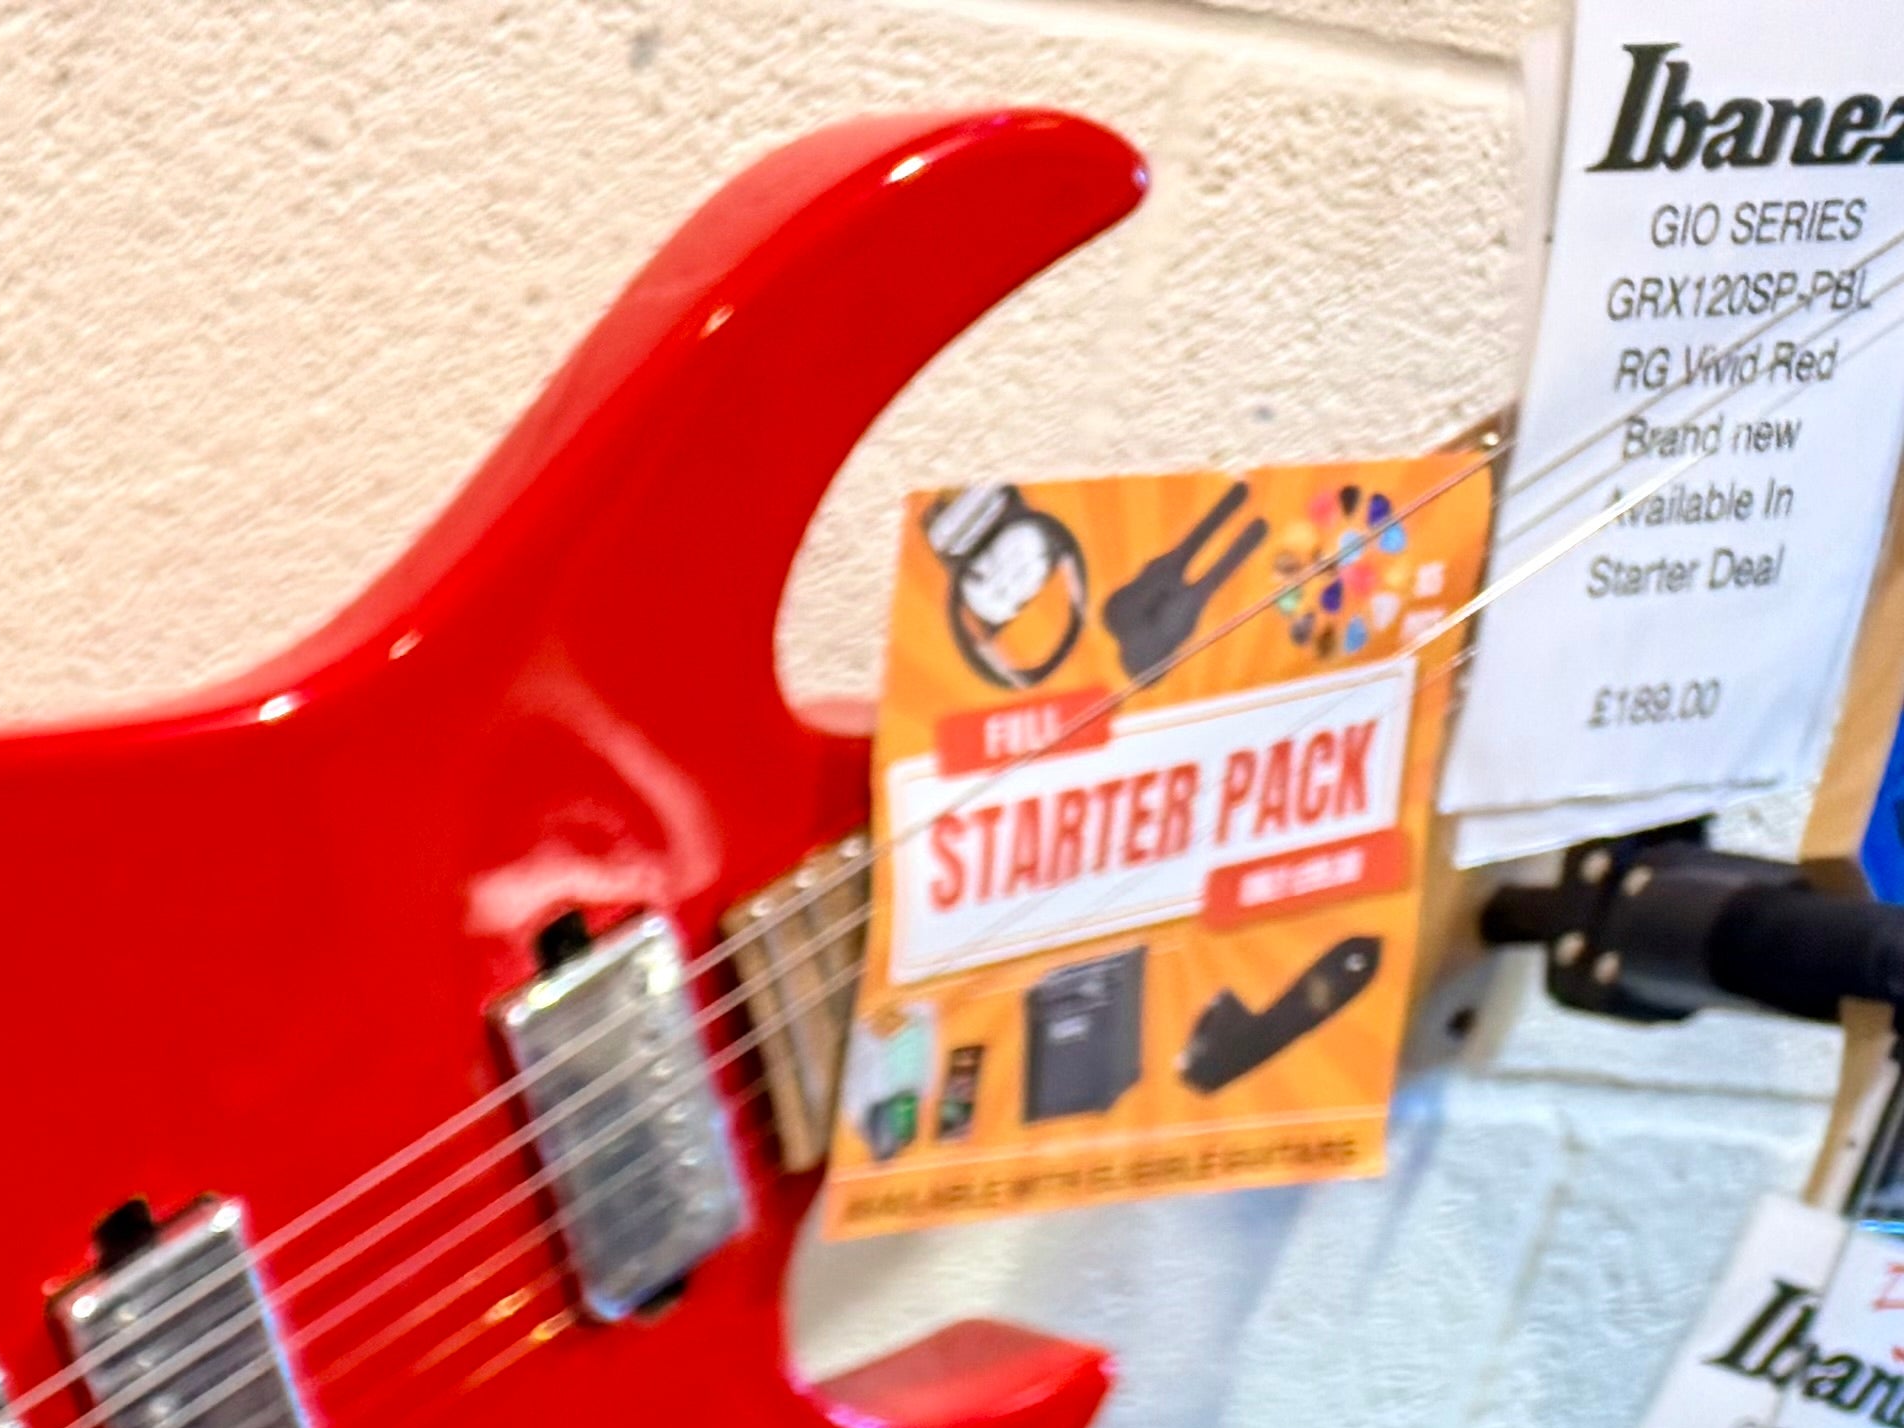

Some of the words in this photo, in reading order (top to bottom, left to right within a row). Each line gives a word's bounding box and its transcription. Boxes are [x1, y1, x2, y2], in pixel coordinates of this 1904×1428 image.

[1651, 203, 1720, 249] GIO
[1730, 199, 1868, 243] SERIES
[1615, 347, 1671, 391] RG
[1684, 342, 1762, 388] Vivid
[1770, 339, 1840, 383] Red
[1622, 415, 1725, 461] Brand
[1730, 418, 1803, 454] new
[1763, 477, 1795, 518] In
[1586, 553, 1698, 600] Starter
[1708, 546, 1786, 590] Deal
[930, 762, 1199, 913] STARTER
[1214, 718, 1379, 845] PACK
